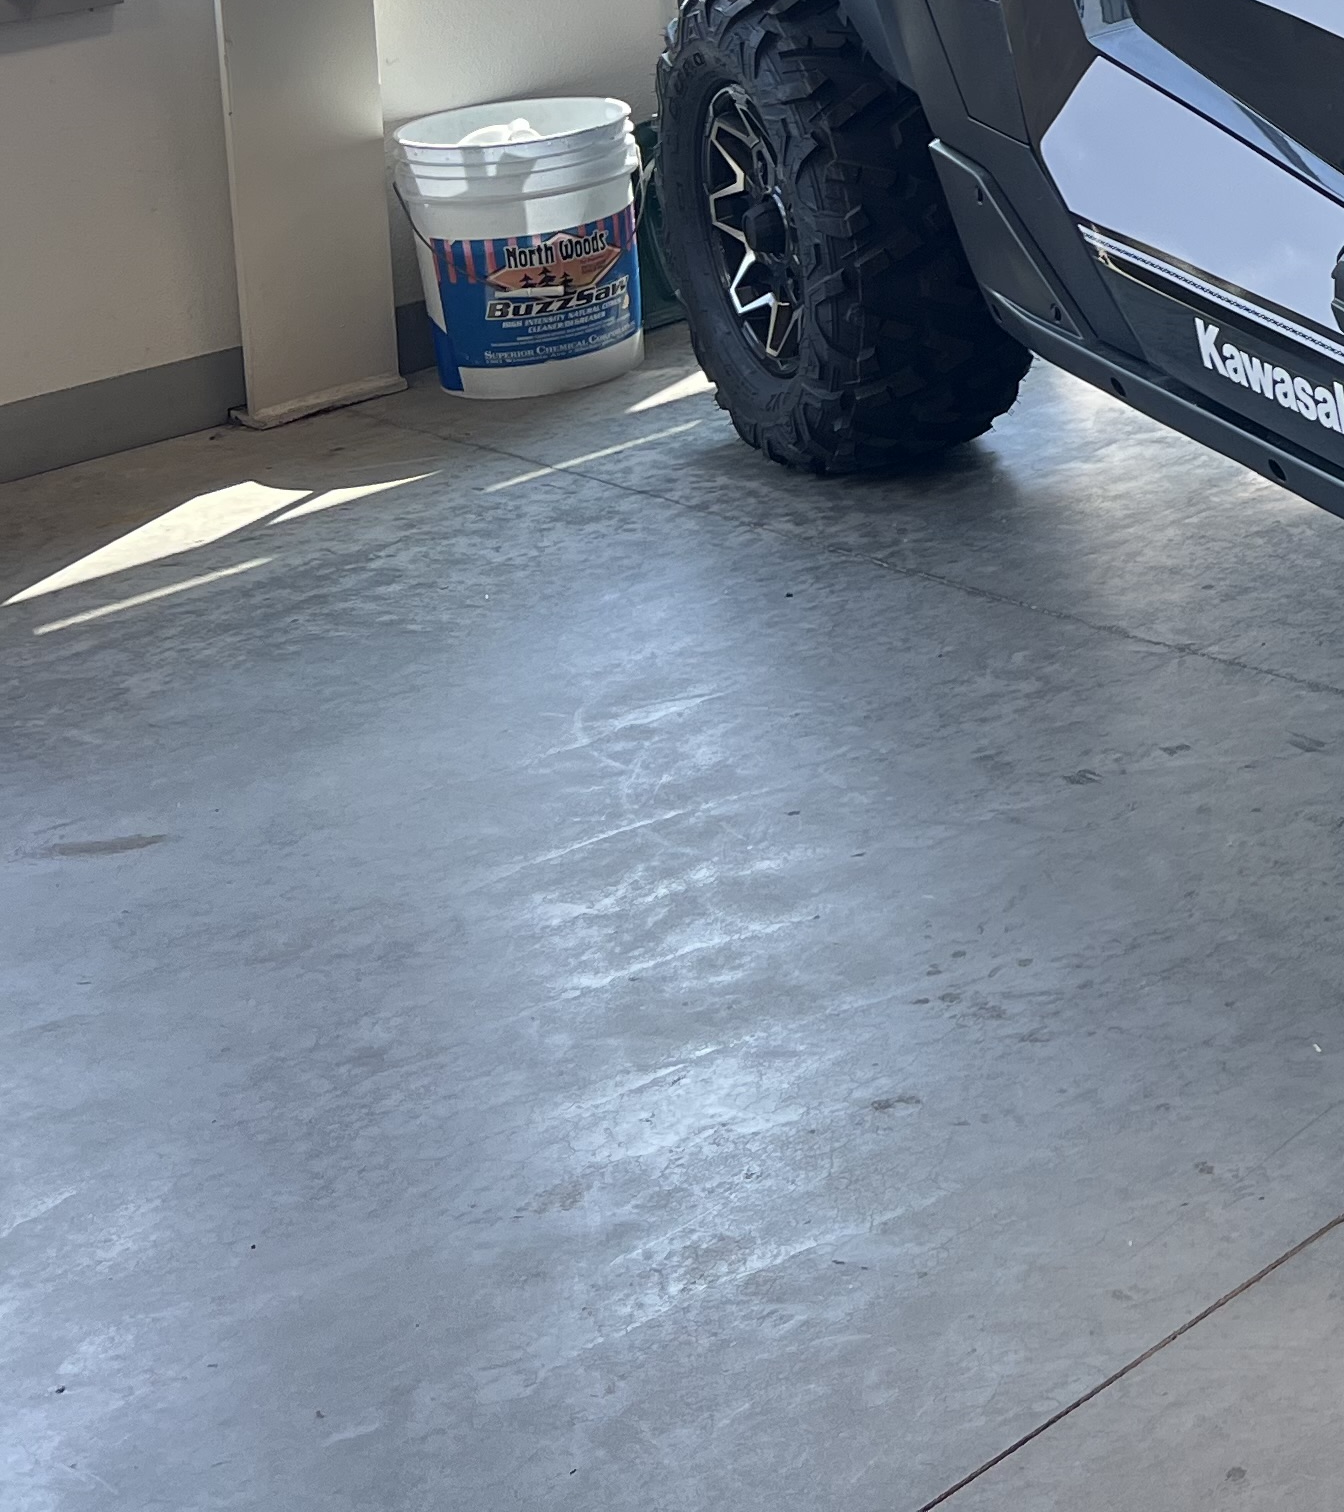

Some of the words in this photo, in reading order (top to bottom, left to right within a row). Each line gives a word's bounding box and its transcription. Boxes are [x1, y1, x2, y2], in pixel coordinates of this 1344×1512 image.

[504, 243, 555, 269] North
[558, 231, 607, 261] Woods
[485, 276, 629, 319] BuzzSaw
[484, 349, 534, 359] SUPERIOR
[536, 341, 588, 355] CHEMICAL
